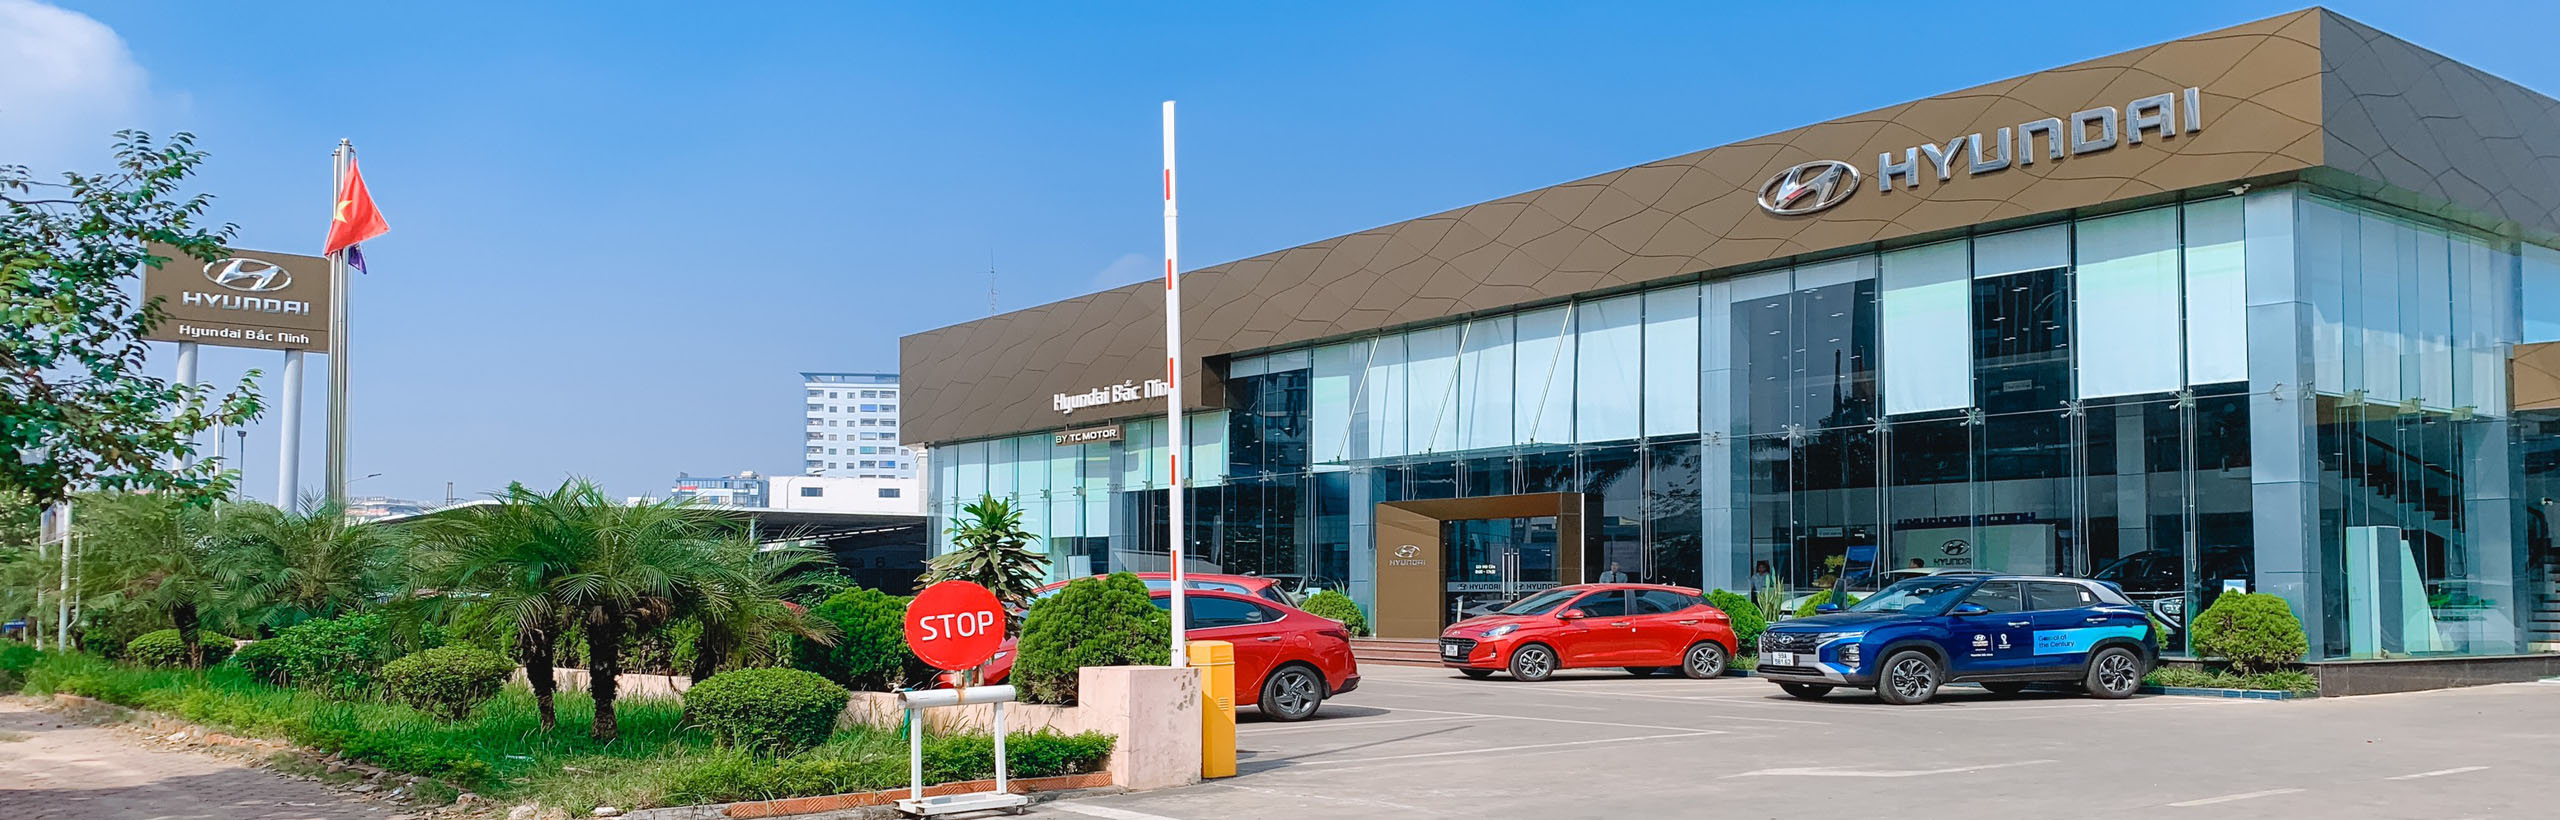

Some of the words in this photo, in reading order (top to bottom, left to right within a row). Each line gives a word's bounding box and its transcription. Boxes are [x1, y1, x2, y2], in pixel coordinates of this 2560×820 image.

[1877, 86, 2202, 193] HYUNDAI
[182, 291, 310, 316] HYUNDAI
[179, 324, 241, 339] Hyundai
[245, 329, 273, 342] Bắc
[278, 332, 309, 344] Ninh
[1053, 387, 1110, 414] Hyundai
[1112, 380, 1141, 403] Bắc
[1144, 379, 1169, 399] Nin
[1056, 435, 1068, 444] BY
[1070, 434, 1082, 442] TC
[1082, 429, 1117, 440] MOTOR
[920, 610, 994, 640] STOP
